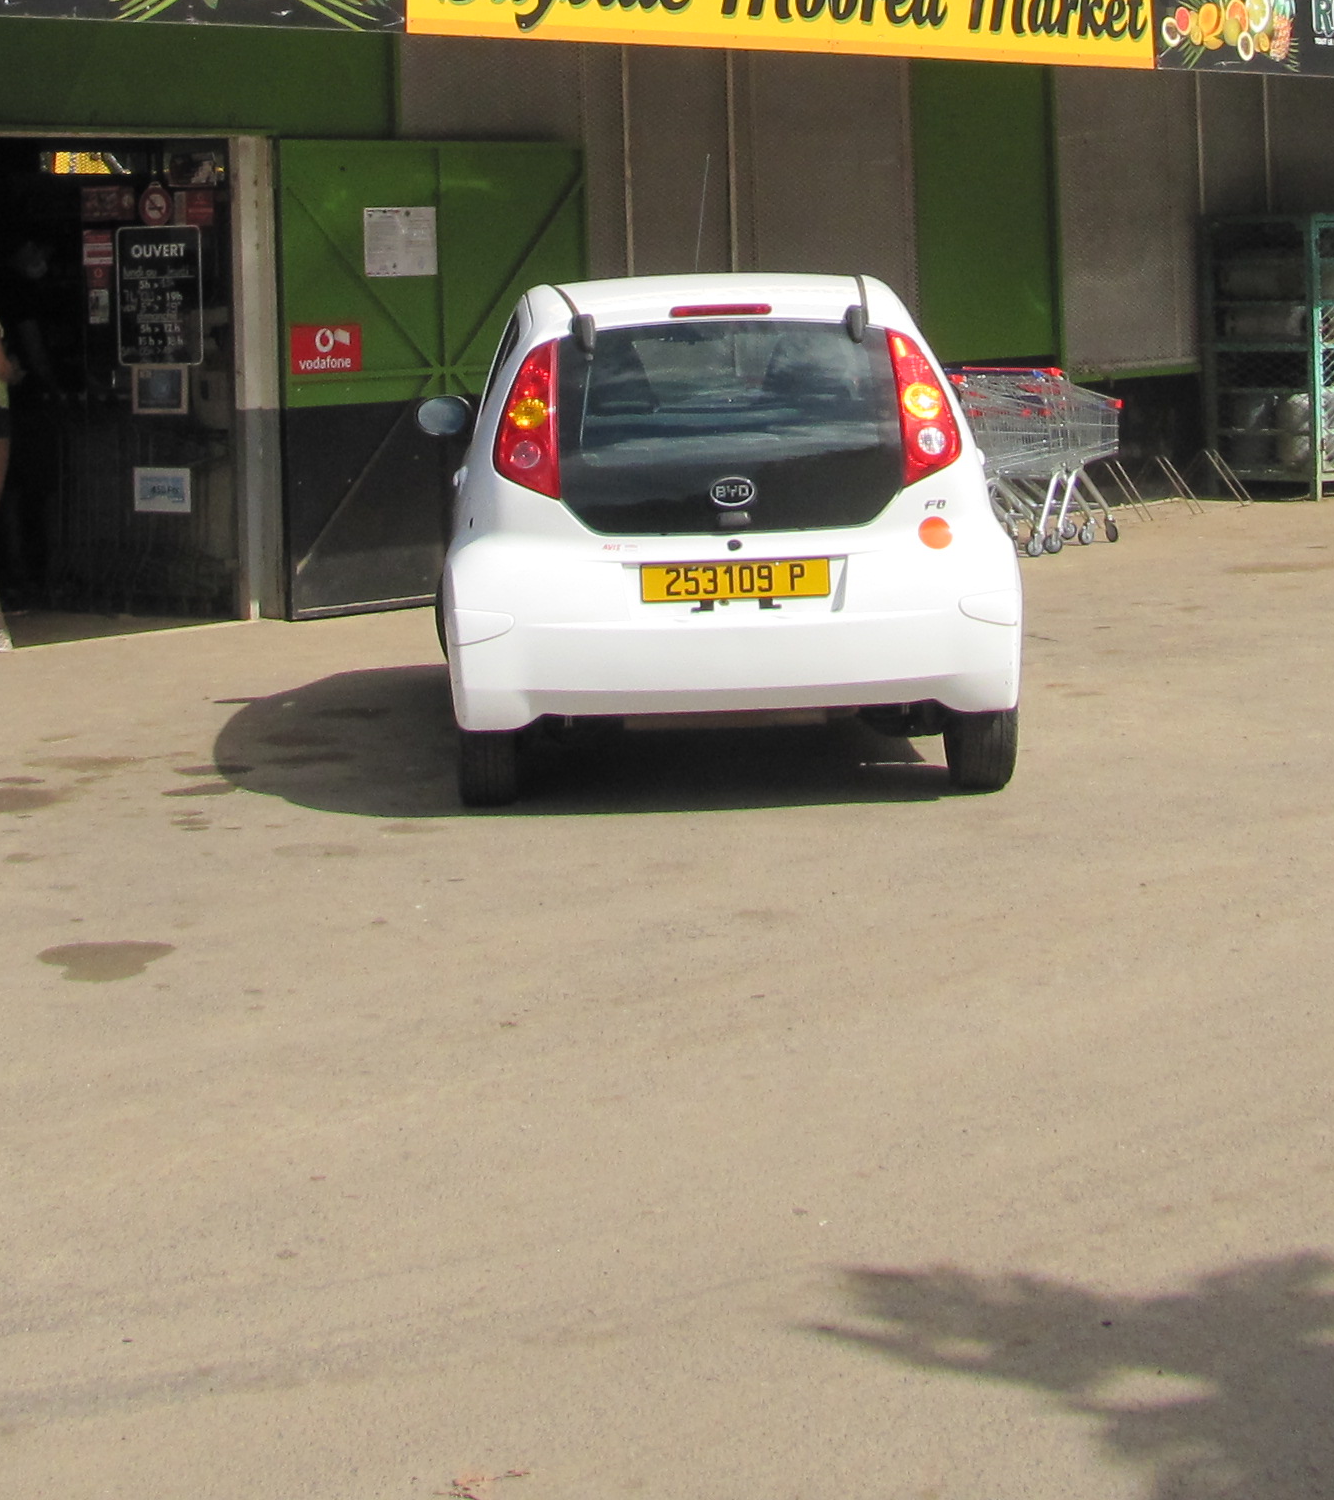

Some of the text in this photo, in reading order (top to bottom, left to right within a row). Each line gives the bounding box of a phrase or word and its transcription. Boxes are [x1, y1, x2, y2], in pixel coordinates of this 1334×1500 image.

[131, 243, 186, 258] OUVERT
[298, 355, 352, 370] vodafone
[715, 485, 750, 498] BYD
[665, 563, 805, 596] 253109 P
